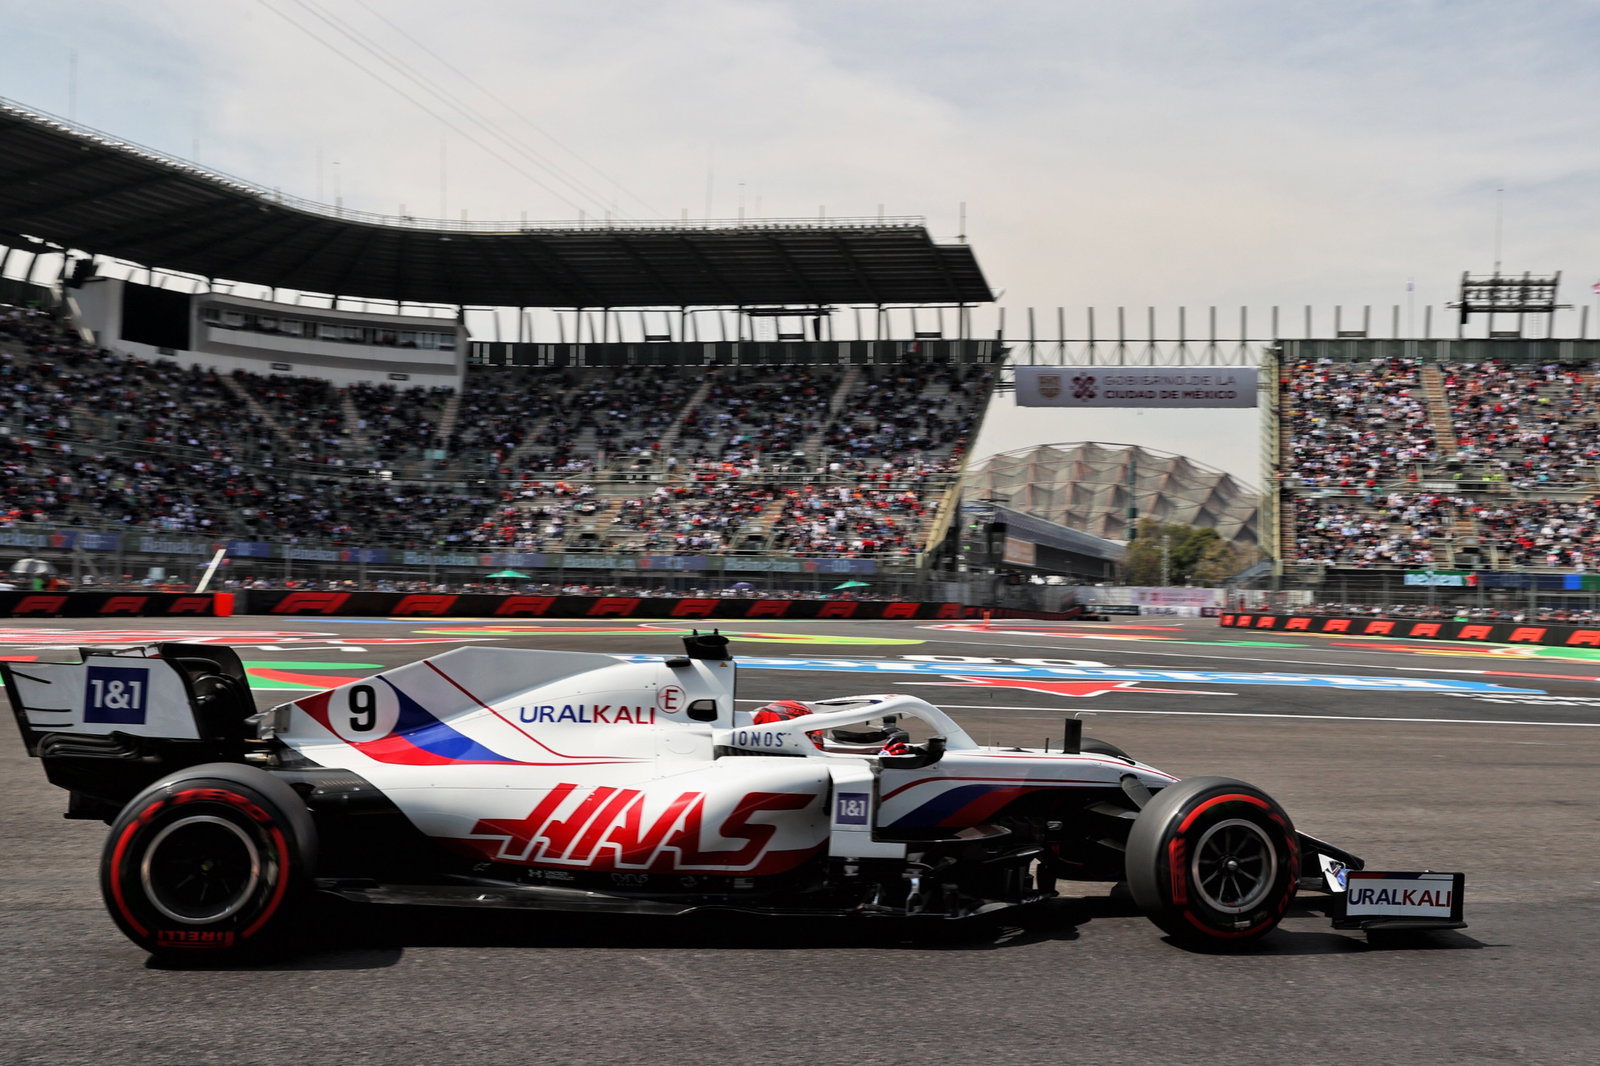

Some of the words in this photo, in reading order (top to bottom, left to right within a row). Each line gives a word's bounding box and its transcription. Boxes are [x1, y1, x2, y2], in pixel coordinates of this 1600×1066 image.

[1102, 375, 1185, 386] GOBIERNO
[1102, 390, 1157, 400] CIUDAD
[1159, 390, 1180, 400] DE
[90, 679, 142, 709] 1&1
[348, 684, 376, 732] 9
[519, 704, 656, 724] URALKALI
[731, 731, 786, 747] IONOS
[839, 799, 866, 817] 1&1
[469, 782, 817, 871] HAAS
[1348, 888, 1452, 908] URALKALI
[156, 929, 235, 948] PIRELLI
